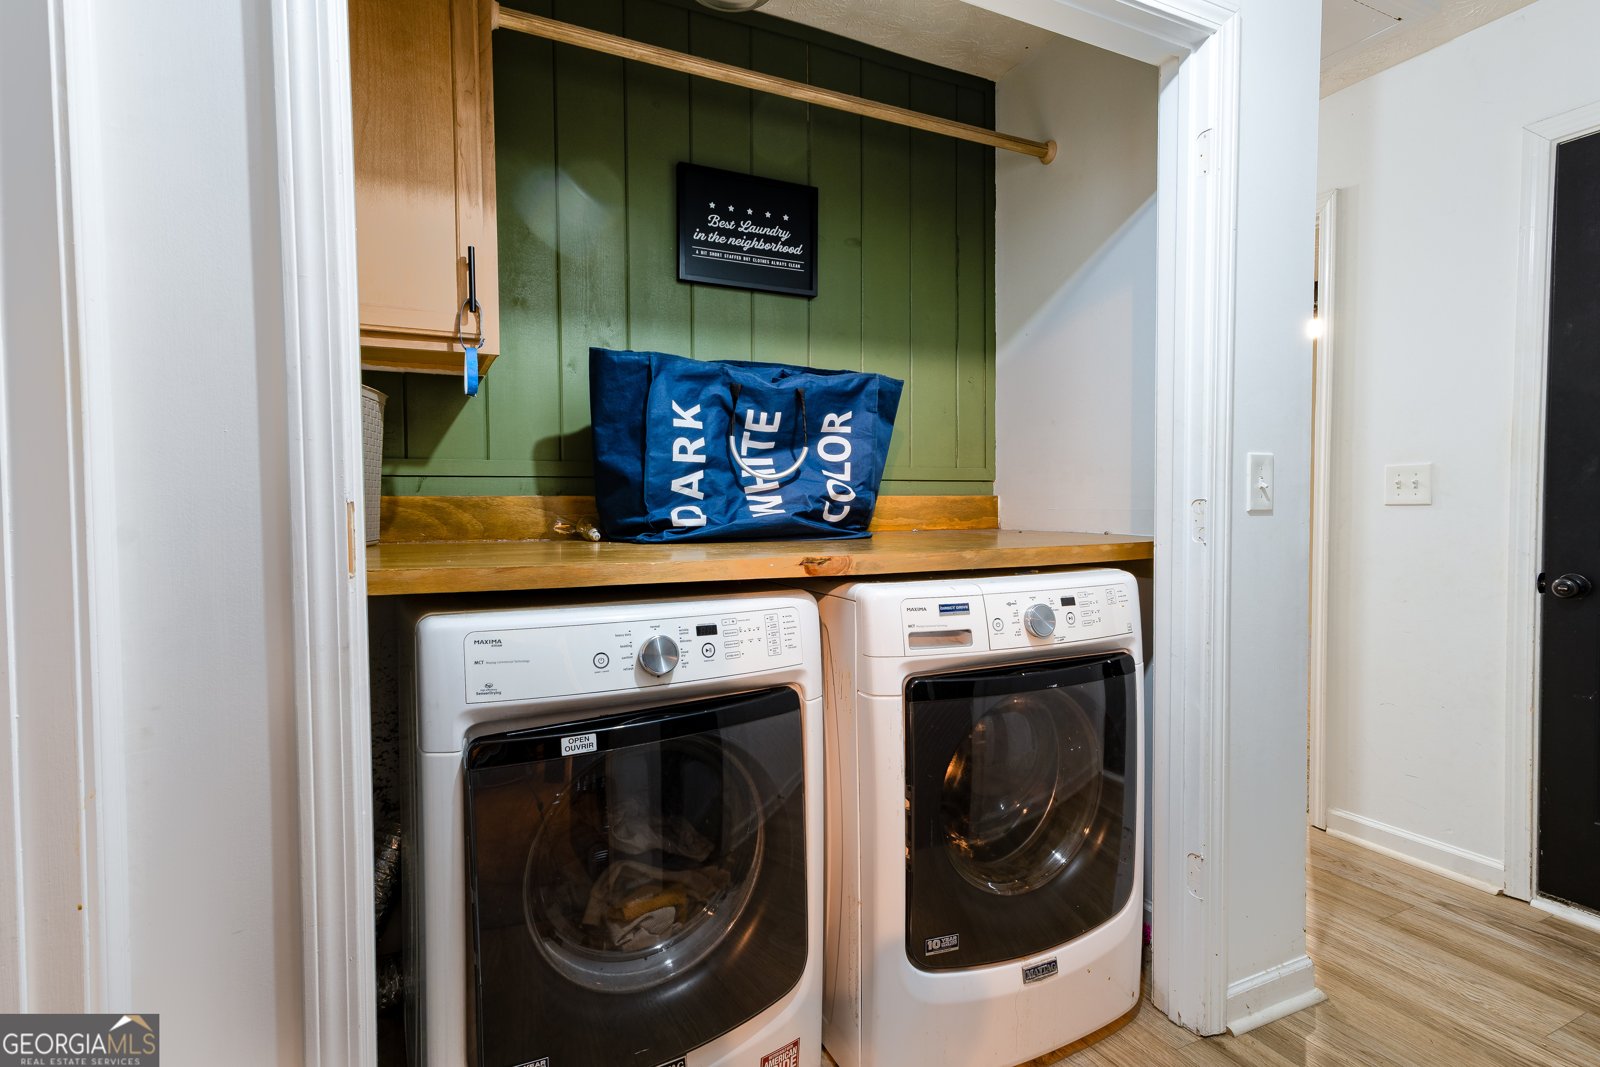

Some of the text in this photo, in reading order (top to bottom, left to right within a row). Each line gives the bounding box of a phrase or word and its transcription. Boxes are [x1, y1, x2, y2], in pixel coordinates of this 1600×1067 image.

[708, 214, 791, 242] Best Laundry
[693, 228, 803, 255] in the neighborhood
[671, 400, 706, 527] DARK
[741, 409, 786, 518] WHITE
[817, 410, 856, 523] COLOR
[564, 742, 594, 752] OUVRIR
[568, 736, 590, 744] OPEN
[927, 939, 941, 950] 10
[941, 935, 957, 943] YEAR
[1025, 963, 1057, 980] MAYTAG
[764, 1045, 797, 1067] AMERICAN
